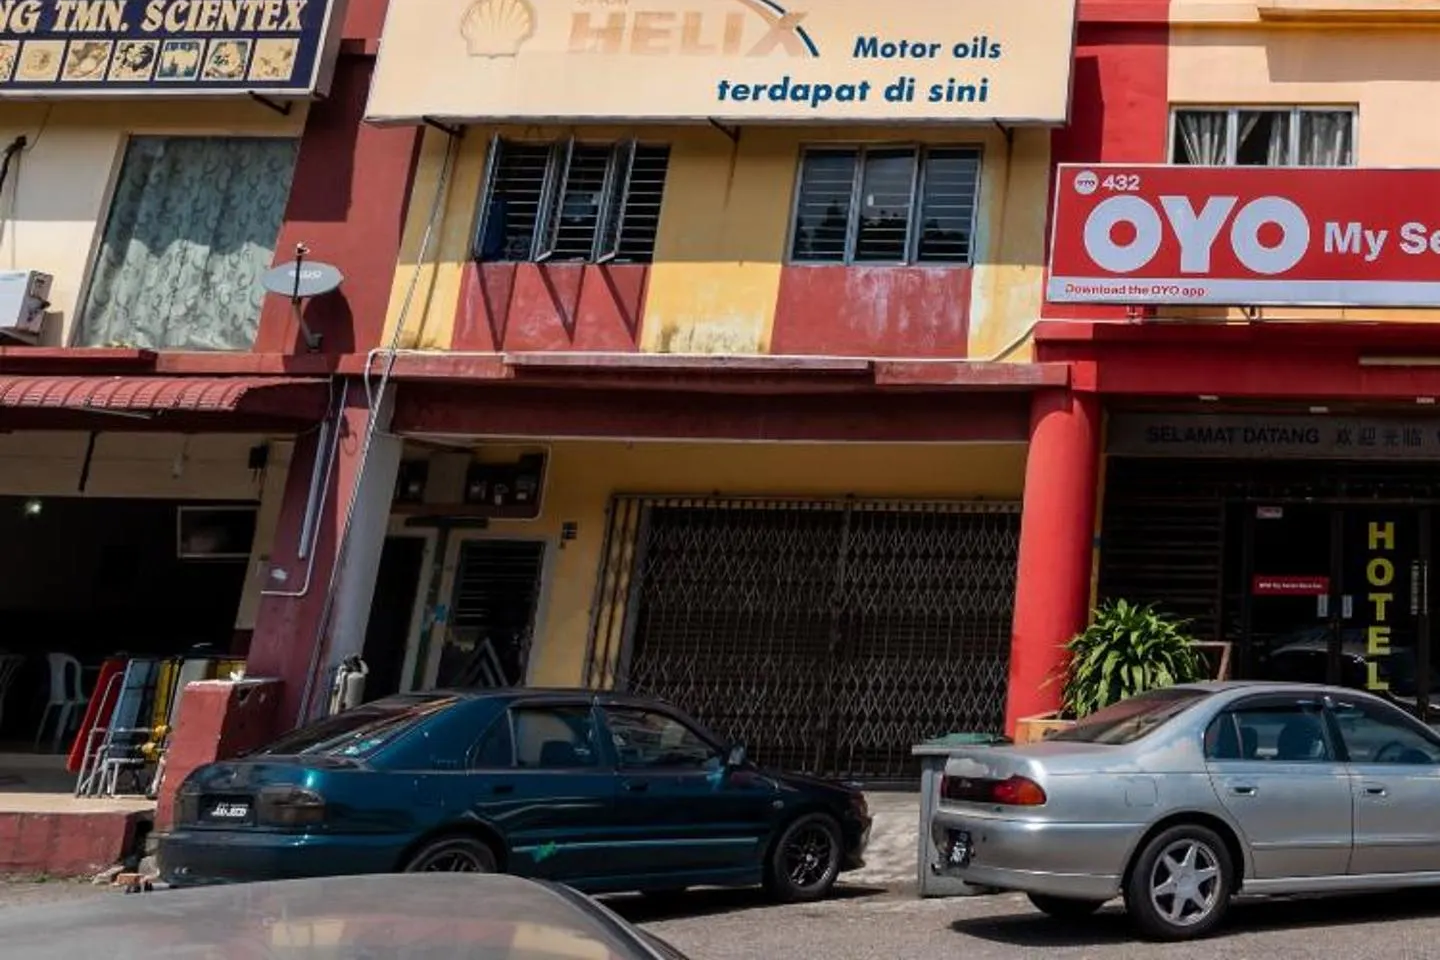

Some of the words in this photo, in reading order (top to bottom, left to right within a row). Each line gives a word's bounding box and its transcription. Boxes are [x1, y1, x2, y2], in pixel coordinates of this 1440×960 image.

[52, 0, 130, 32] TMN.
[568, 8, 820, 58] HELIX
[853, 35, 941, 59] Motor
[952, 35, 1002, 59] oils
[717, 78, 870, 108] terdapat
[884, 77, 916, 102] di
[929, 77, 989, 102] sini
[1102, 175, 1140, 191] 432
[1084, 194, 1310, 275] OYO
[1324, 220, 1387, 262] My
[1145, 426, 1239, 444] SELAMAT
[1243, 426, 1321, 445] DATANG
[1366, 521, 1396, 692] HOTEL
